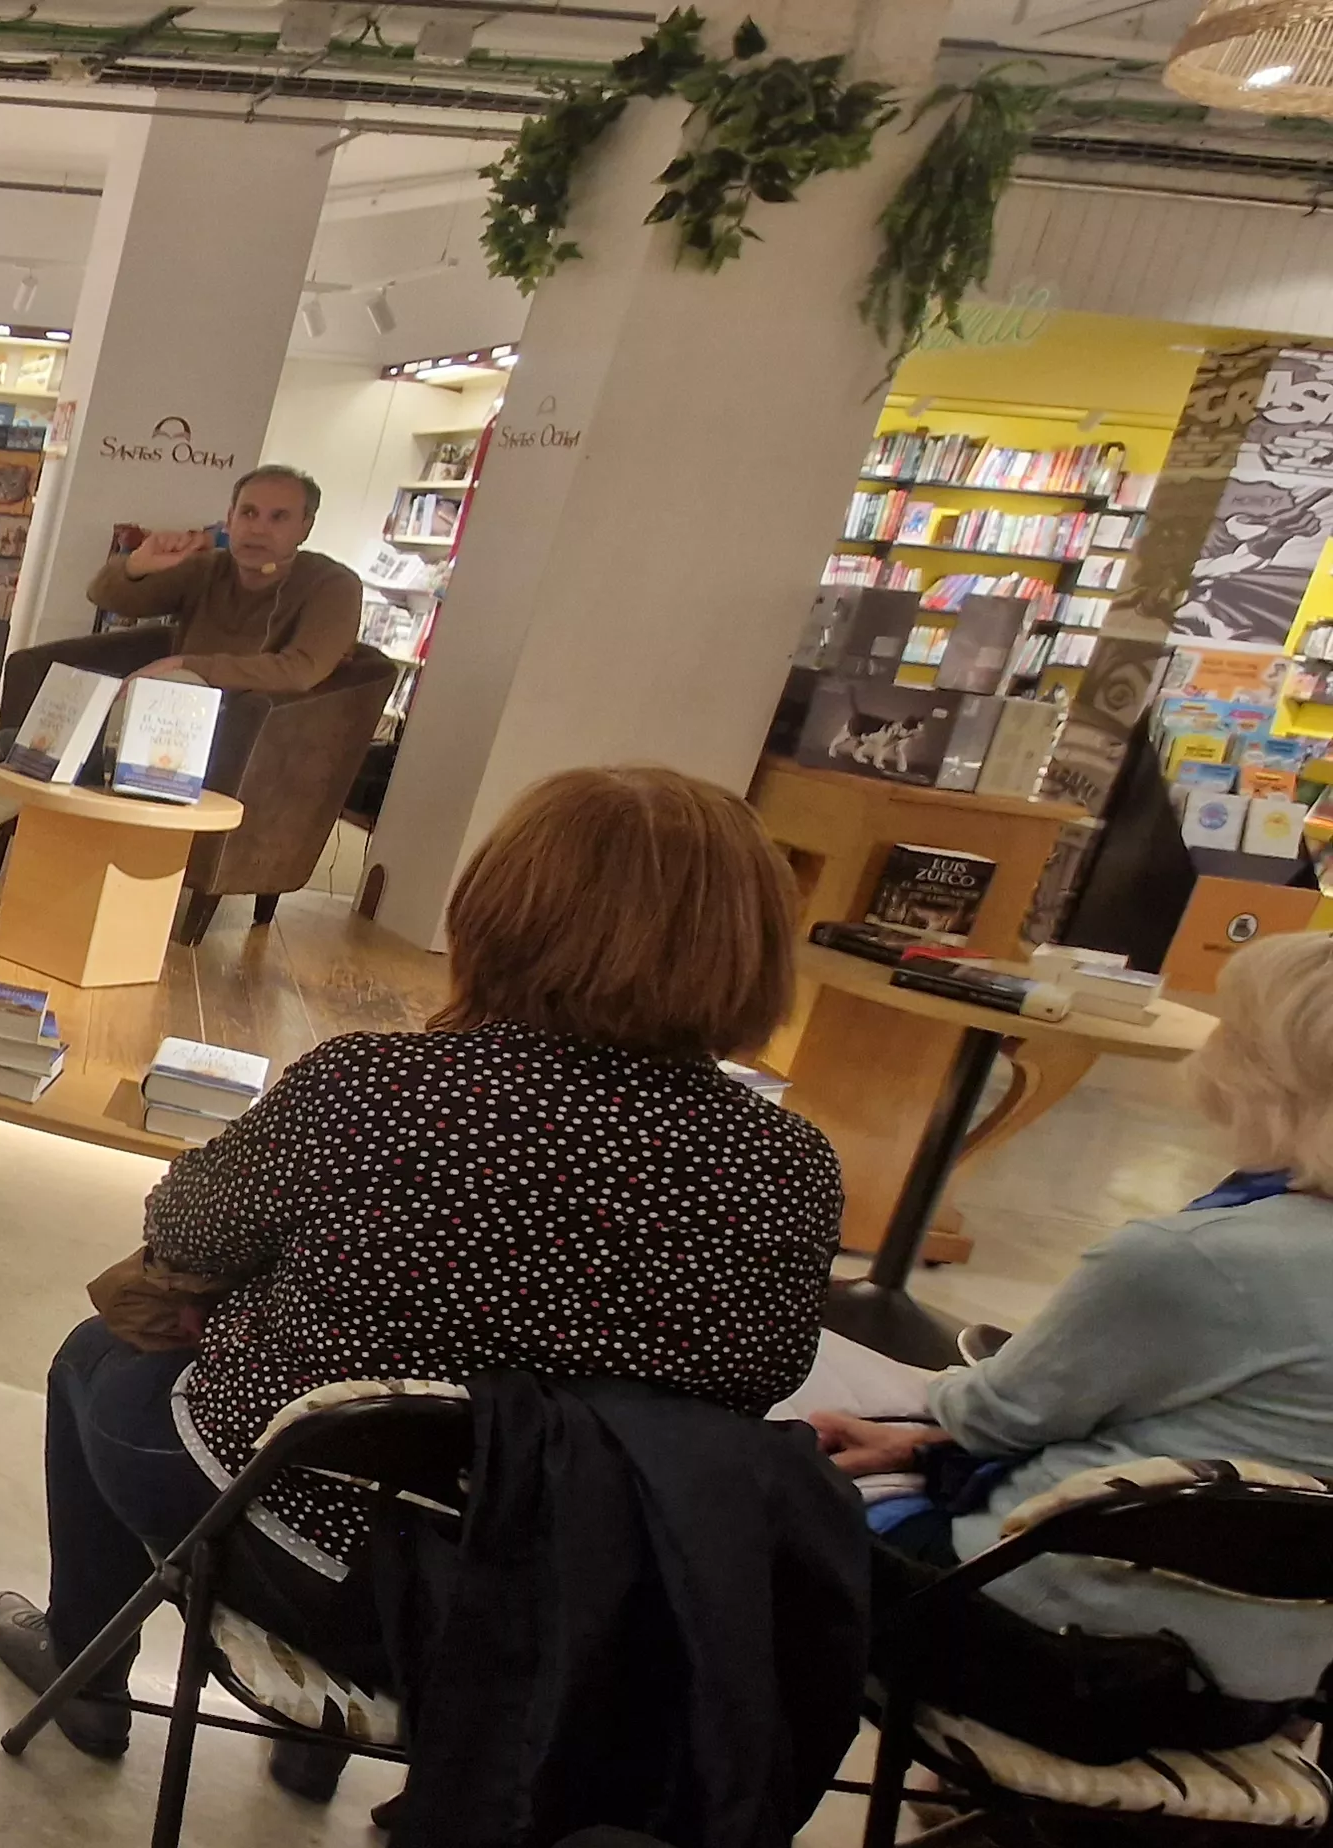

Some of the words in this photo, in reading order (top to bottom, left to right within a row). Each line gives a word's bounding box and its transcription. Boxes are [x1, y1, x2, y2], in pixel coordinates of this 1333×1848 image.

[498, 425, 536, 449] SANTOS
[540, 423, 581, 449] OCHOA
[99, 435, 163, 462] SANTOS
[171, 442, 236, 471] OCHOA
[915, 867, 976, 887] ZUECO
[931, 857, 970, 874] LUIS
